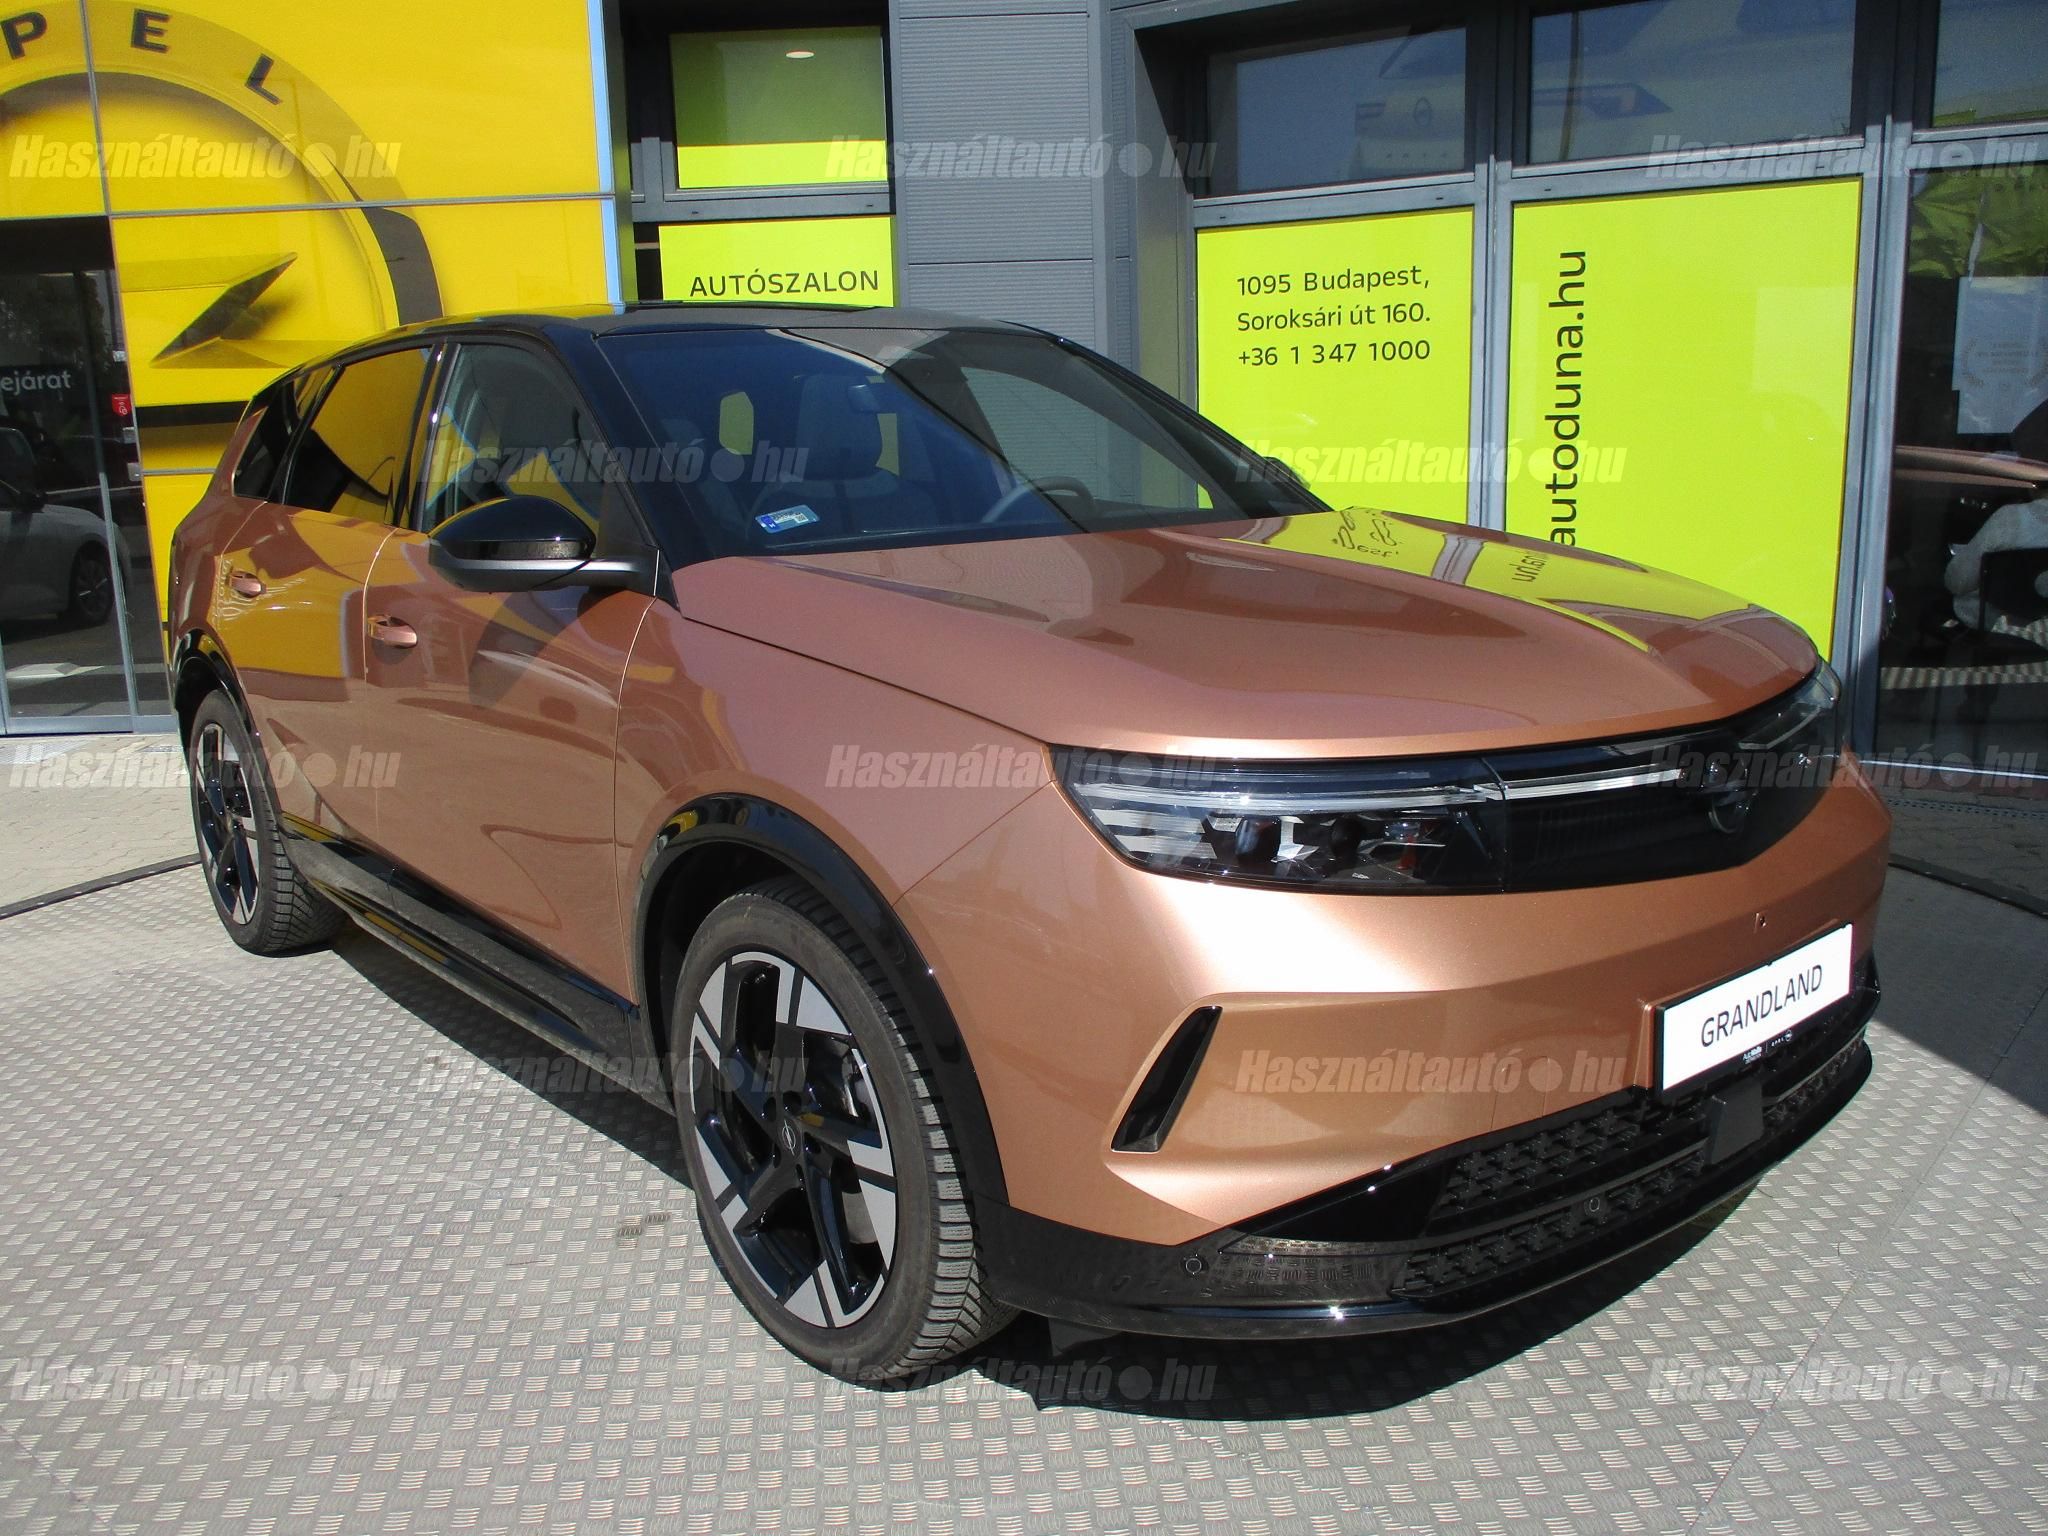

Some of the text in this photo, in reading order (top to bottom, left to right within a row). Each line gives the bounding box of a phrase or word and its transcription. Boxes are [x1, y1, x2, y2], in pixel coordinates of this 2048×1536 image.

[690, 268, 878, 297] AUTÓSZALON
[1237, 265, 1430, 296] 1095 Budapest,
[1237, 302, 1431, 332] Soroksári út 160.
[1238, 339, 1431, 366] +36 1 347 1000
[1545, 251, 1586, 547] autoduna.hu
[1701, 965, 1822, 1047] GRANDLAND
